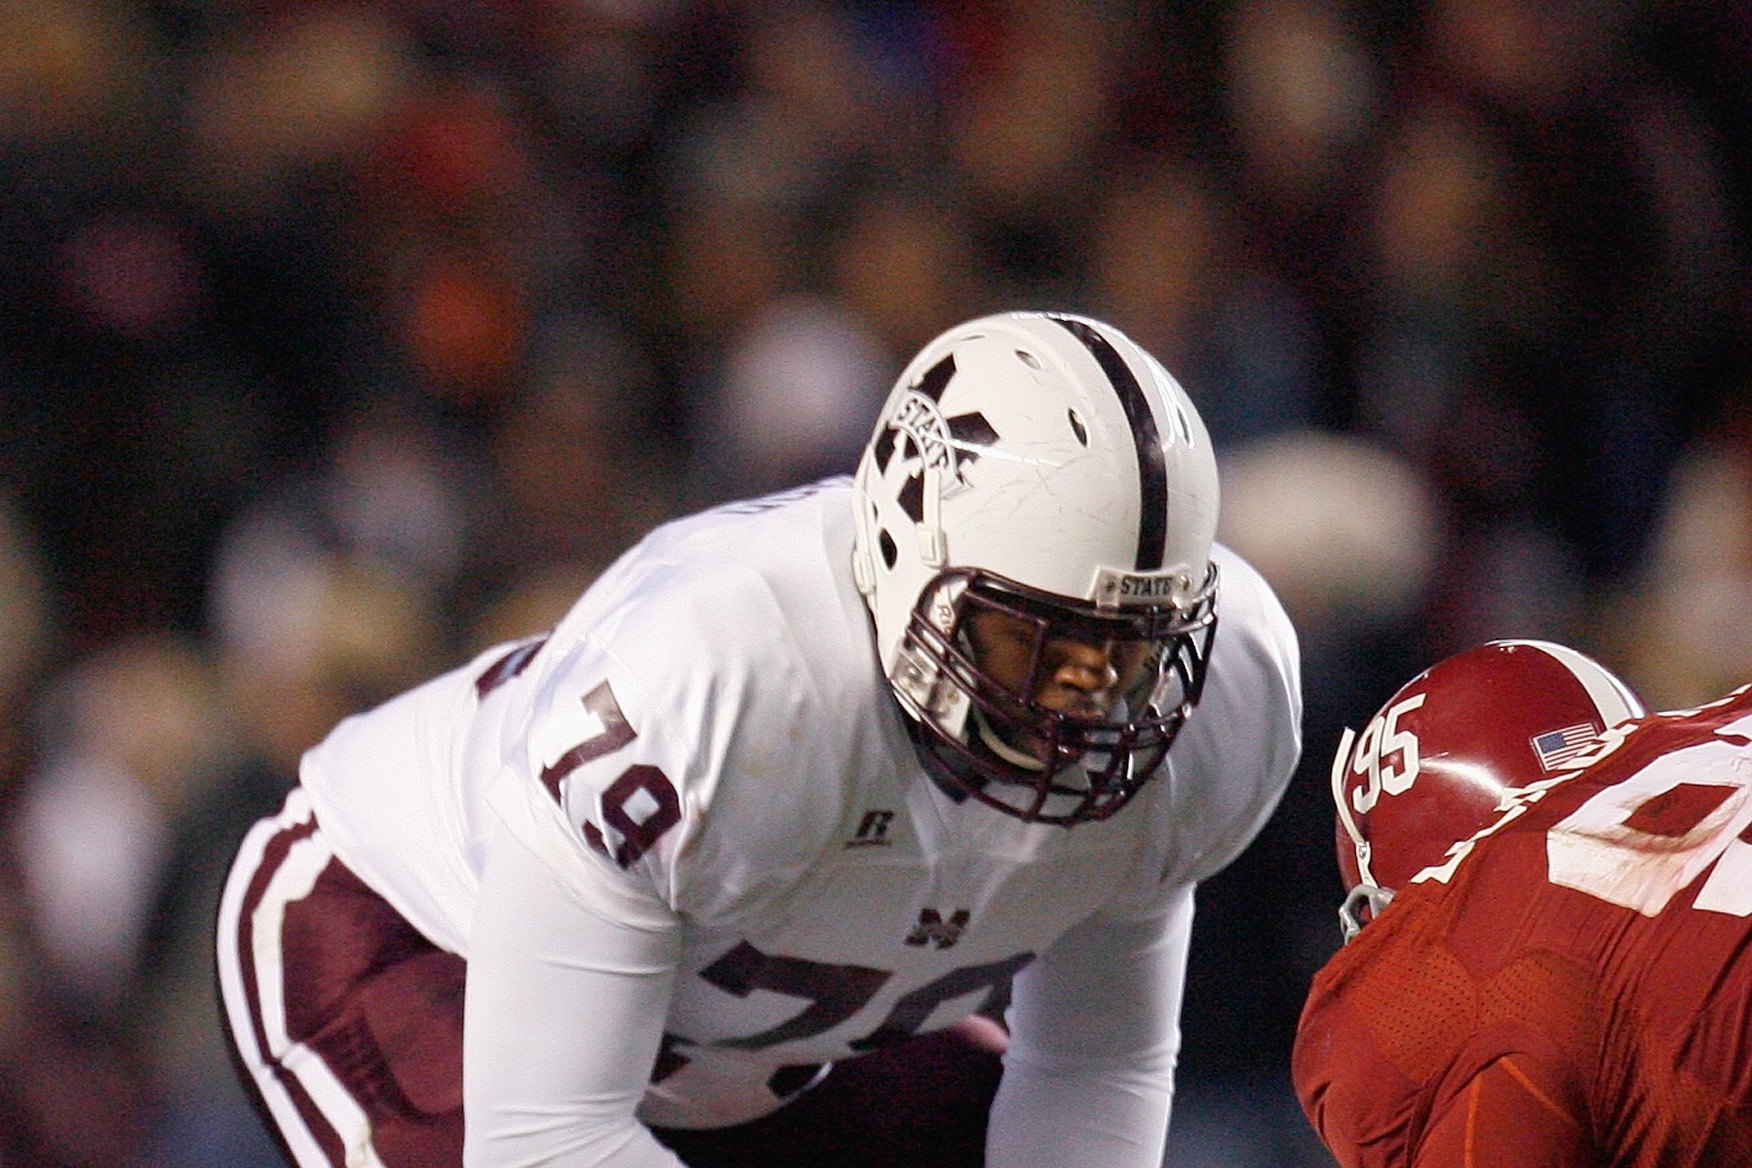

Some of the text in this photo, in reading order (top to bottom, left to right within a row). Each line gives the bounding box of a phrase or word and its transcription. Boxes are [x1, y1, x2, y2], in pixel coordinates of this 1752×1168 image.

[1120, 575, 1172, 596] STATE
[539, 679, 682, 869] 79
[1353, 692, 1426, 814] 95
